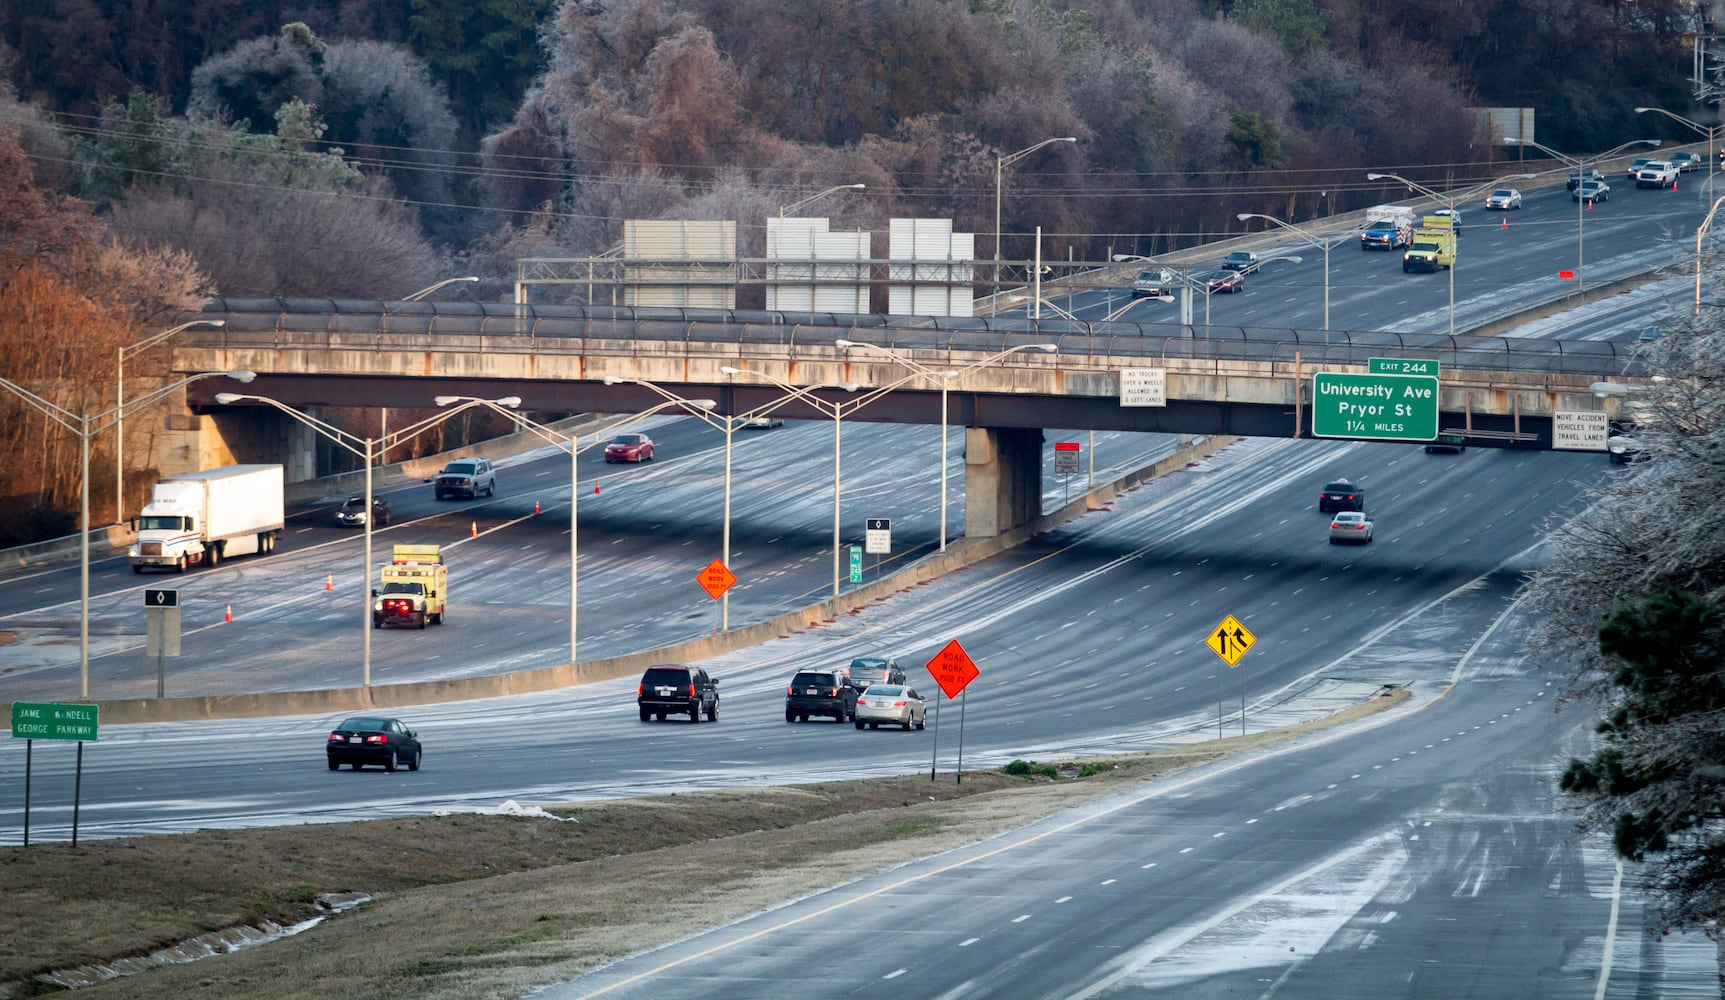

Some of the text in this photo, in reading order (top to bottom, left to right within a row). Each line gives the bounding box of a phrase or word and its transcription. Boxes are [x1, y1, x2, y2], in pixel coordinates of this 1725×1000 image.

[1402, 363, 1427, 373] 244
[1320, 382, 1432, 400] University Ave
[1338, 402, 1412, 417] Pryor St
[1374, 424, 1404, 432] MILES
[943, 653, 965, 662] ROAD
[942, 664, 964, 673] WORK
[17, 724, 92, 735] GEORGE PARKWAY
